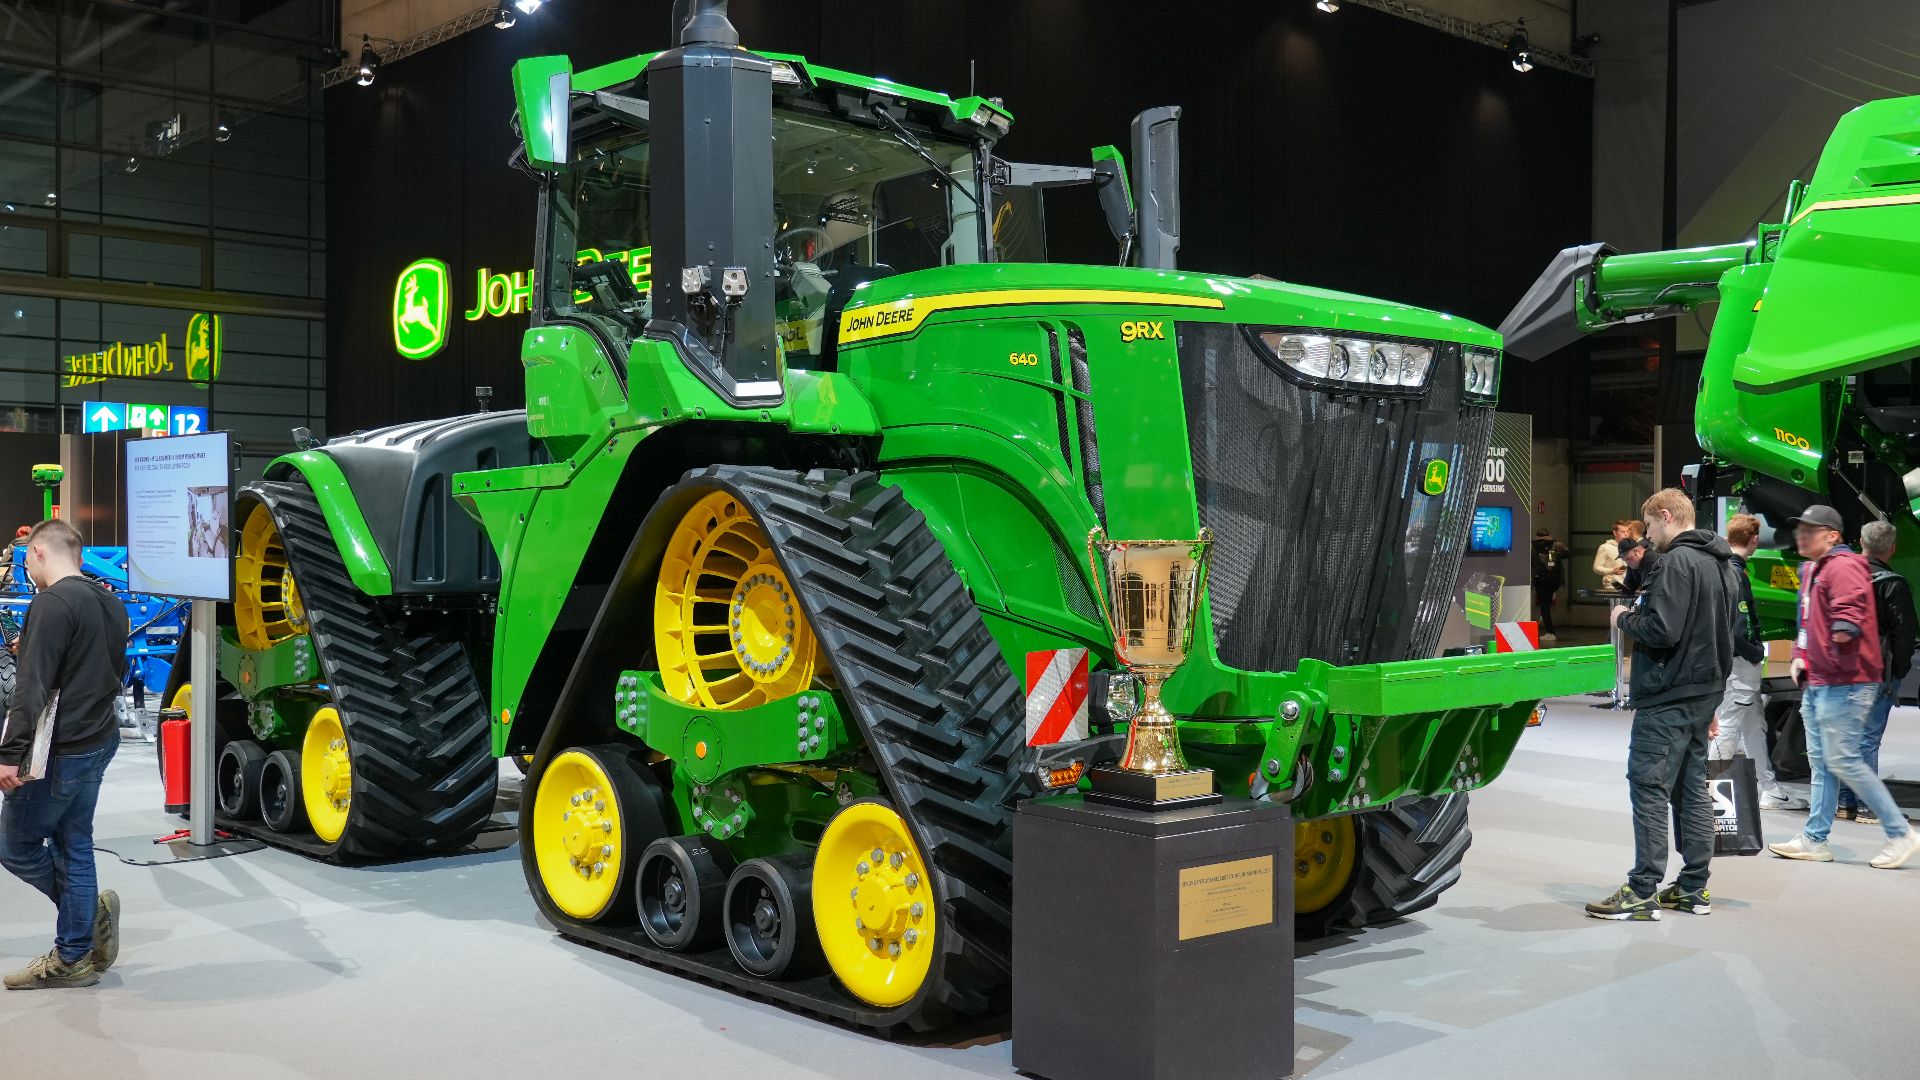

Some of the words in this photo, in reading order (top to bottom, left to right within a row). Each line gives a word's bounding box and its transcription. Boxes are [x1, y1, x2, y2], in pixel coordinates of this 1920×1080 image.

[465, 268, 535, 321] JOH
[846, 315, 875, 333] JOHN
[875, 307, 915, 327] DEERE
[1120, 321, 1165, 342] 9RX
[1009, 352, 1038, 366] 640
[175, 413, 201, 434] 12
[1774, 427, 1810, 451] 1100
[1482, 458, 1505, 482] 00
